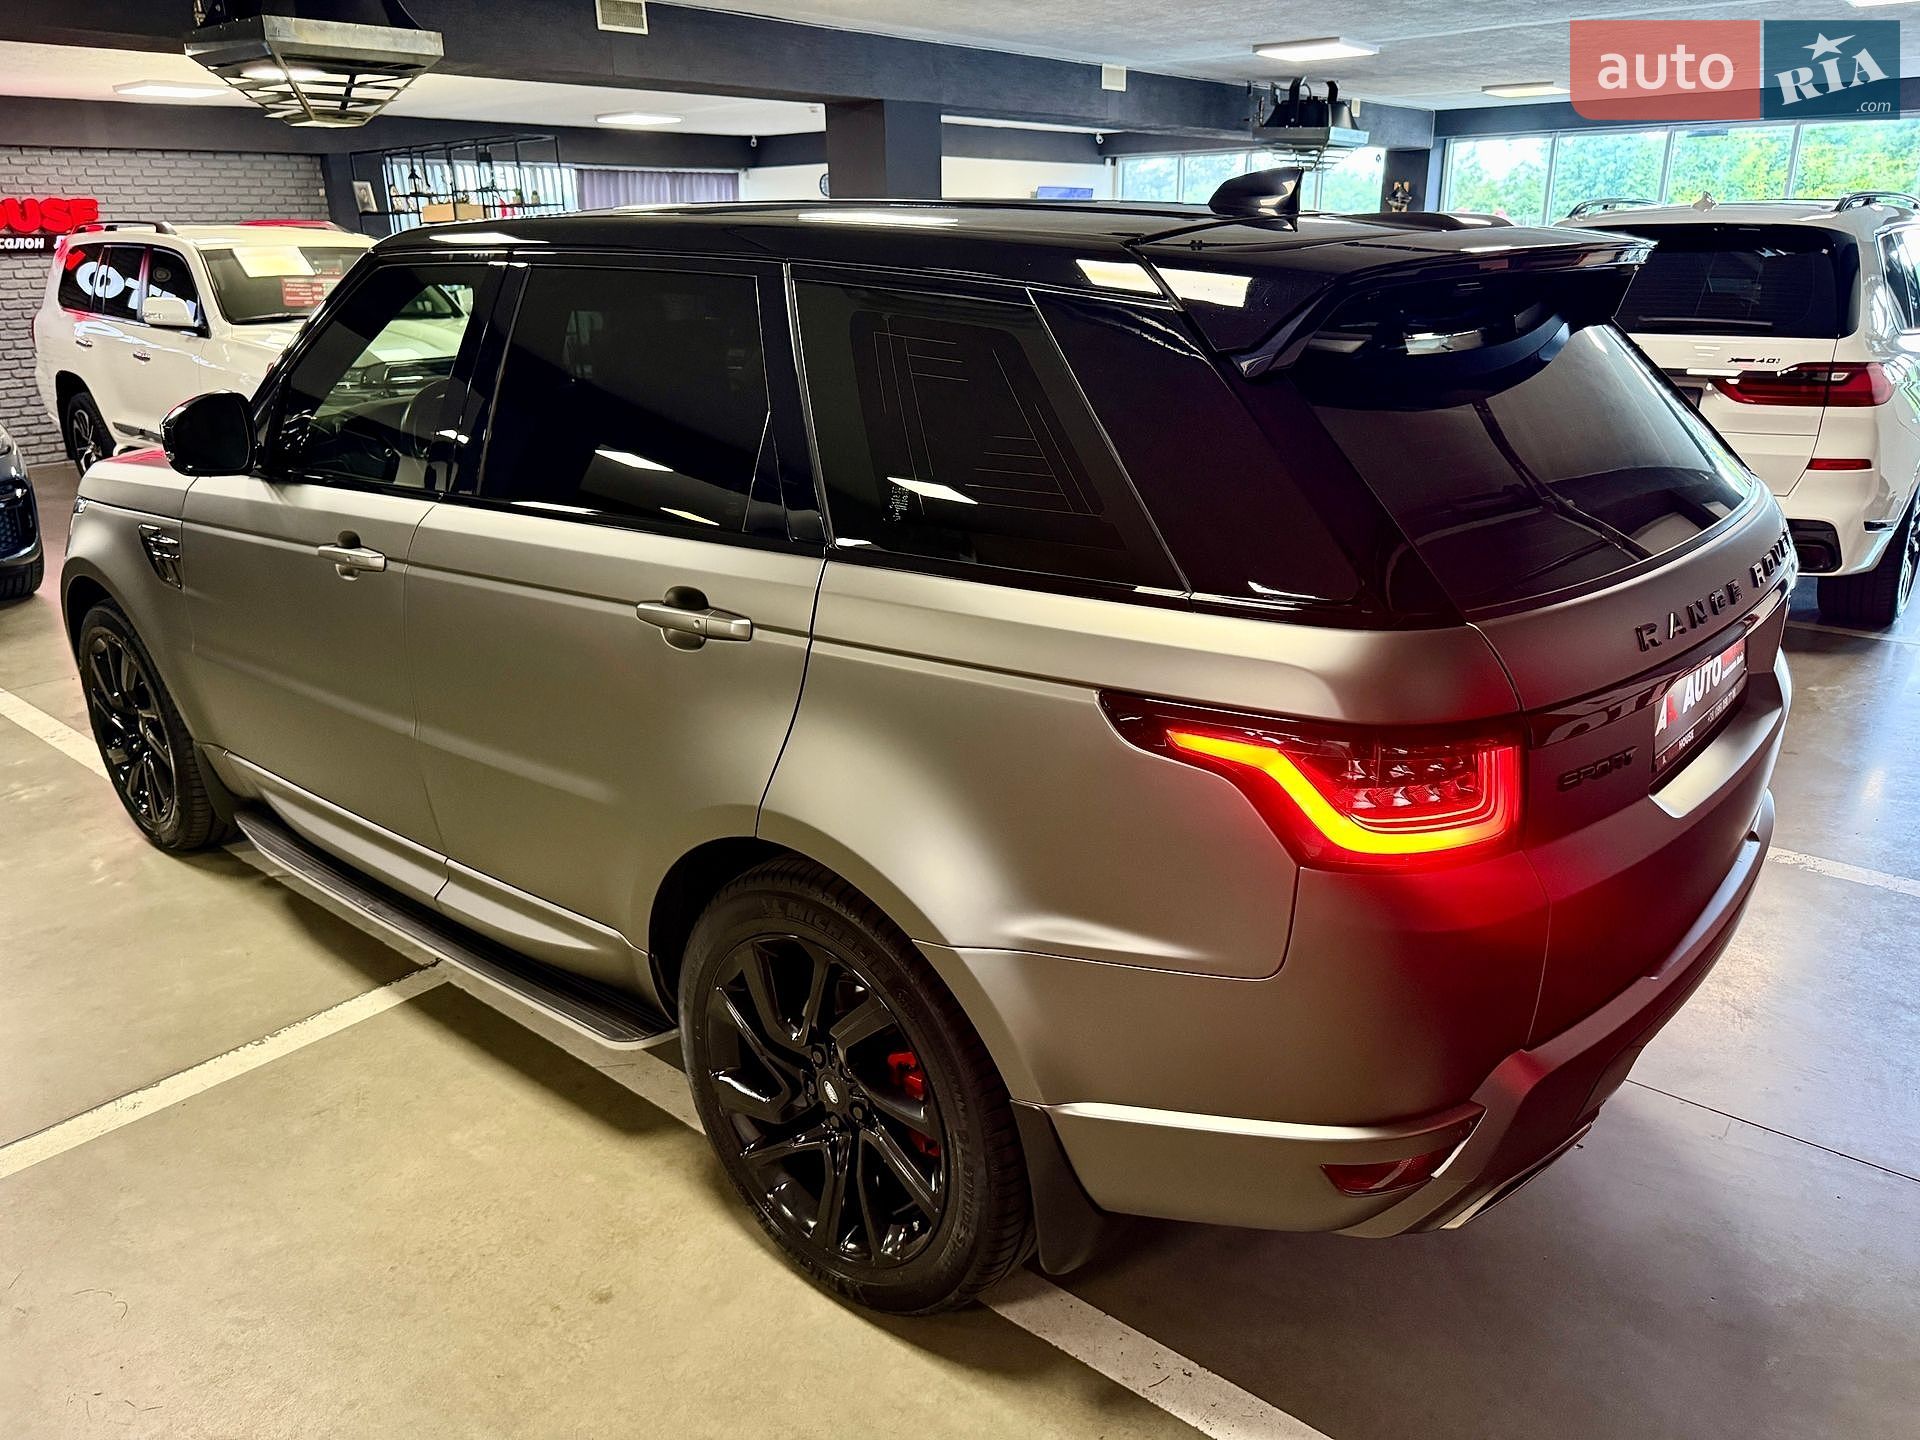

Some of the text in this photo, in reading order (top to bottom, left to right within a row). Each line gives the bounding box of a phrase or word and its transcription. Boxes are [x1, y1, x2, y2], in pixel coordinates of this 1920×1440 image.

[0, 197, 98, 233] USE
[1634, 578, 1744, 653] RANGE
[1682, 655, 1723, 714] AUTO
[1557, 746, 1640, 792] SPORT
